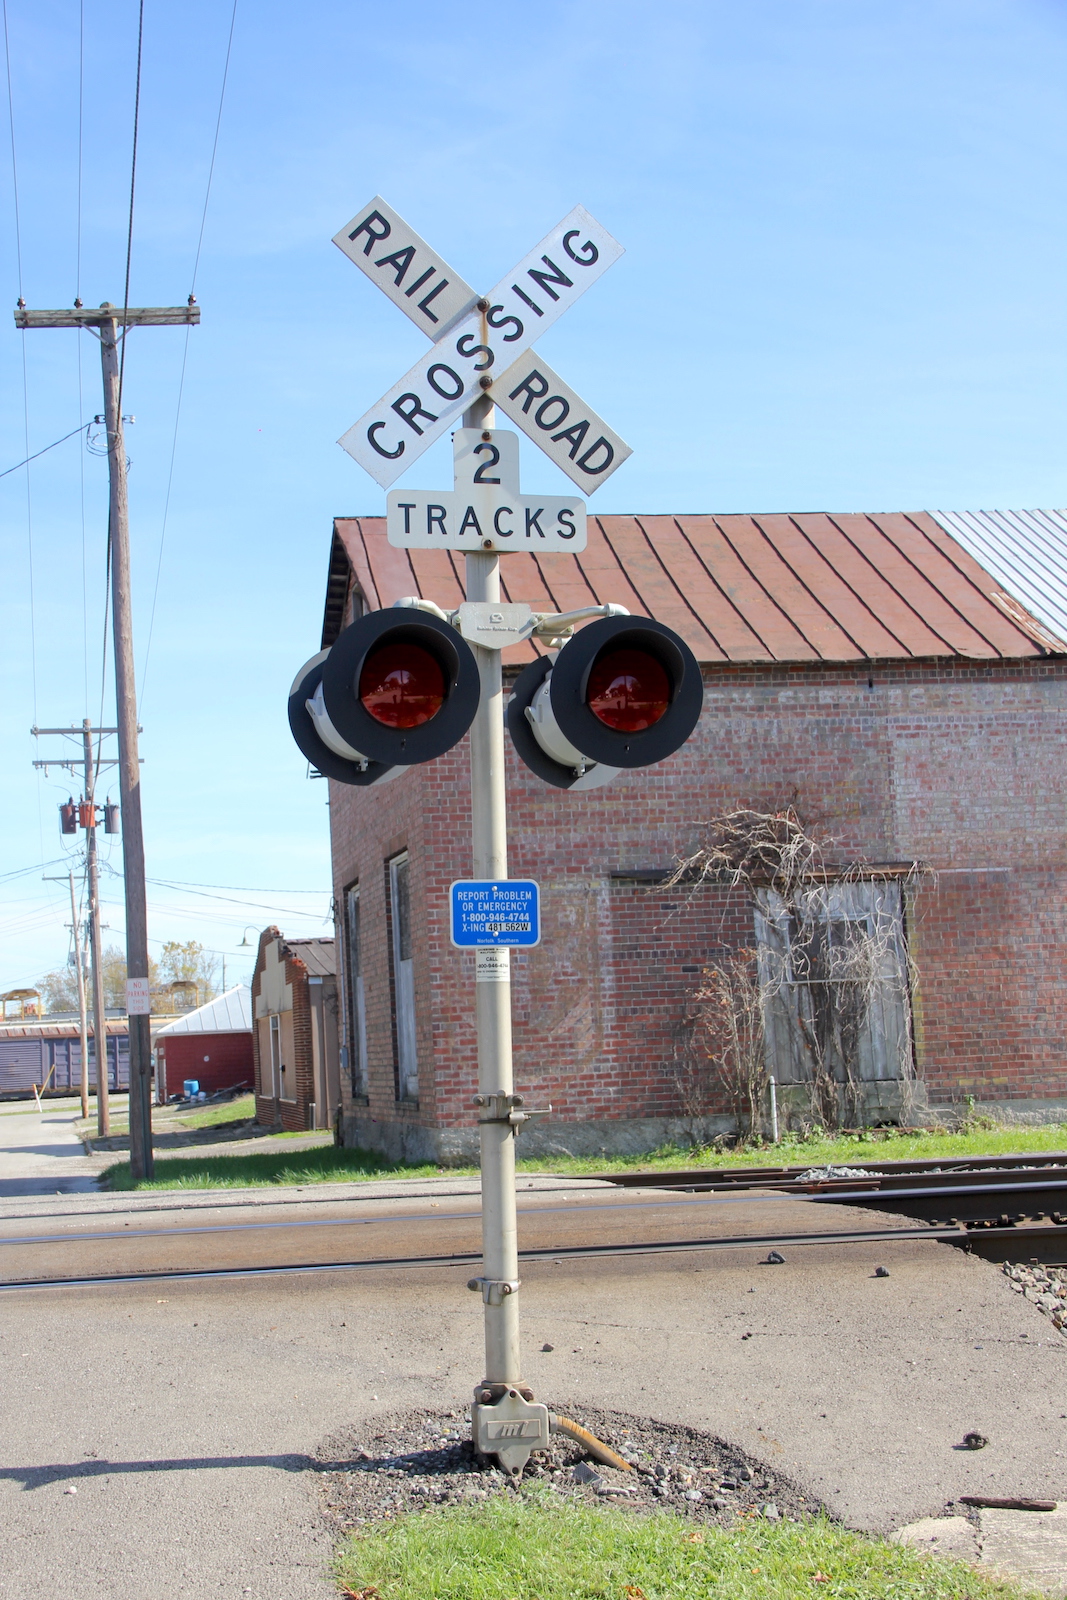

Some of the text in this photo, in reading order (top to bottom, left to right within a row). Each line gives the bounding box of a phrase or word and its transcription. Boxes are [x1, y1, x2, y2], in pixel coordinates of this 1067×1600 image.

[348, 209, 450, 324] RAIL
[366, 229, 600, 460] CROSSING
[508, 368, 615, 476] ROAD
[473, 442, 501, 485] 2
[397, 503, 577, 540] TRACKS
[457, 891, 532, 900] REPORT PROBLEM
[462, 902, 527, 911] OR EMERGENCY
[462, 913, 529, 922] 1-800-946-4744
[462, 922, 529, 932] X-ING 481 562W
